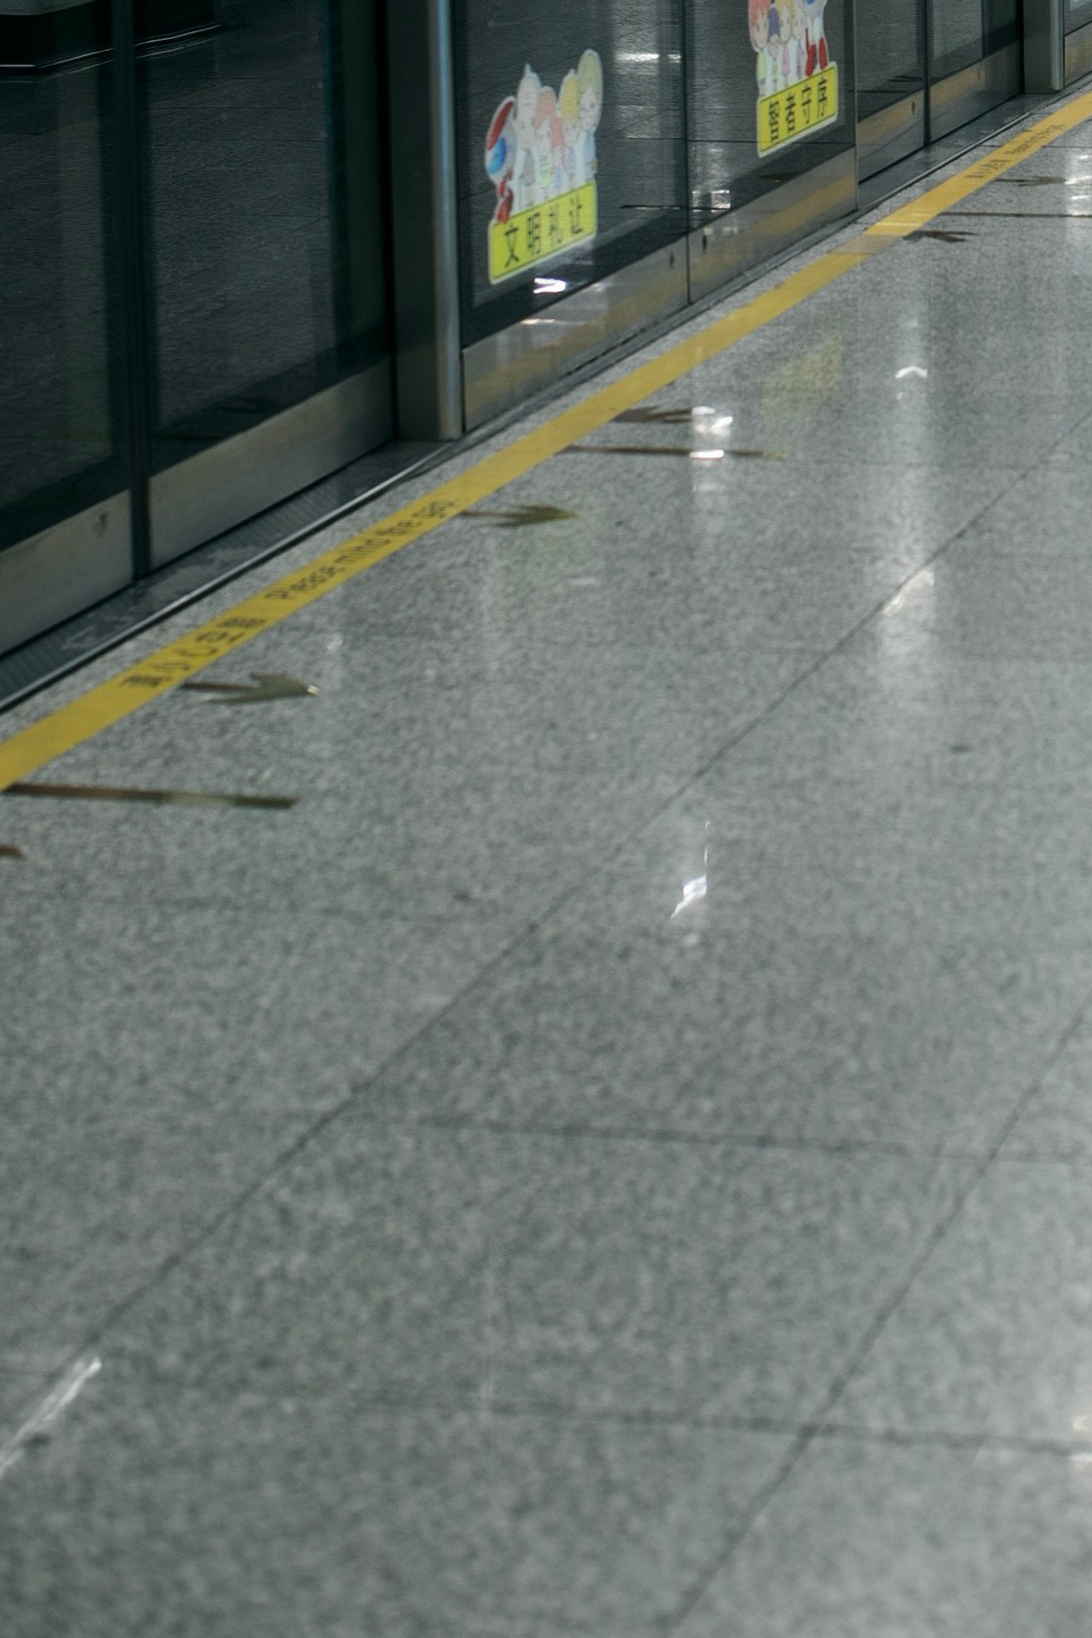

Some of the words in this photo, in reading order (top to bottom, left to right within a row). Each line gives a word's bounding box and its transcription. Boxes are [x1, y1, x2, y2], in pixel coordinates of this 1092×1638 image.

[503, 196, 585, 269] 文明礼让
[263, 563, 348, 600] Please
[412, 499, 455, 518] gap
